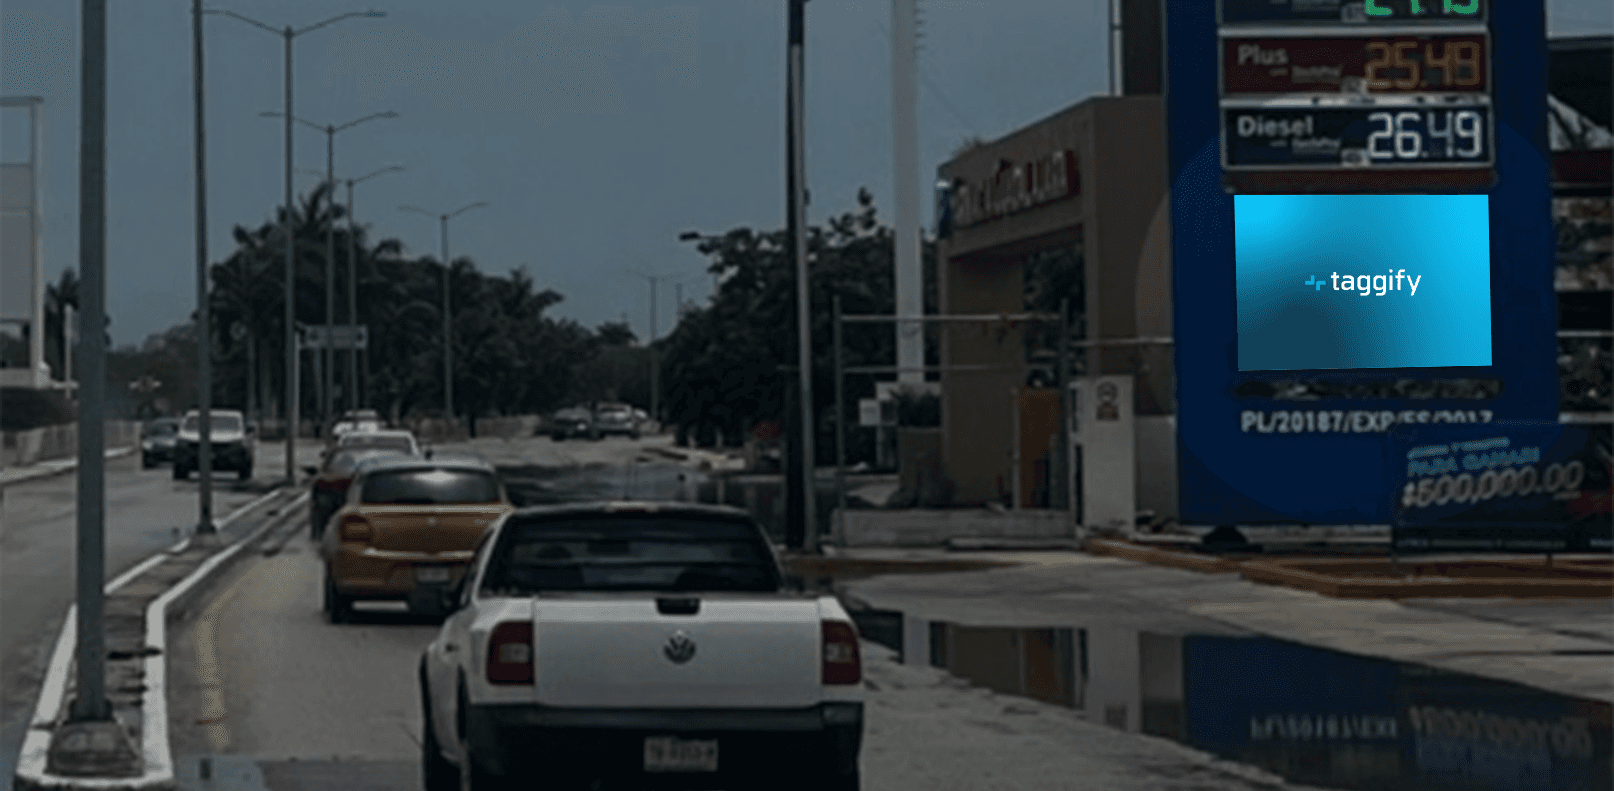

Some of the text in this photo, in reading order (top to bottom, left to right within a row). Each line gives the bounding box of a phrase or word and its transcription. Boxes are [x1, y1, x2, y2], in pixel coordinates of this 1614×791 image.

[1237, 44, 1289, 66] Plus
[1364, 40, 1481, 89] 25.49
[1237, 114, 1314, 137] Diesel
[1367, 111, 1483, 159] 26.49
[1330, 268, 1422, 297] taggify
[1402, 459, 1585, 508] $500,000.00
